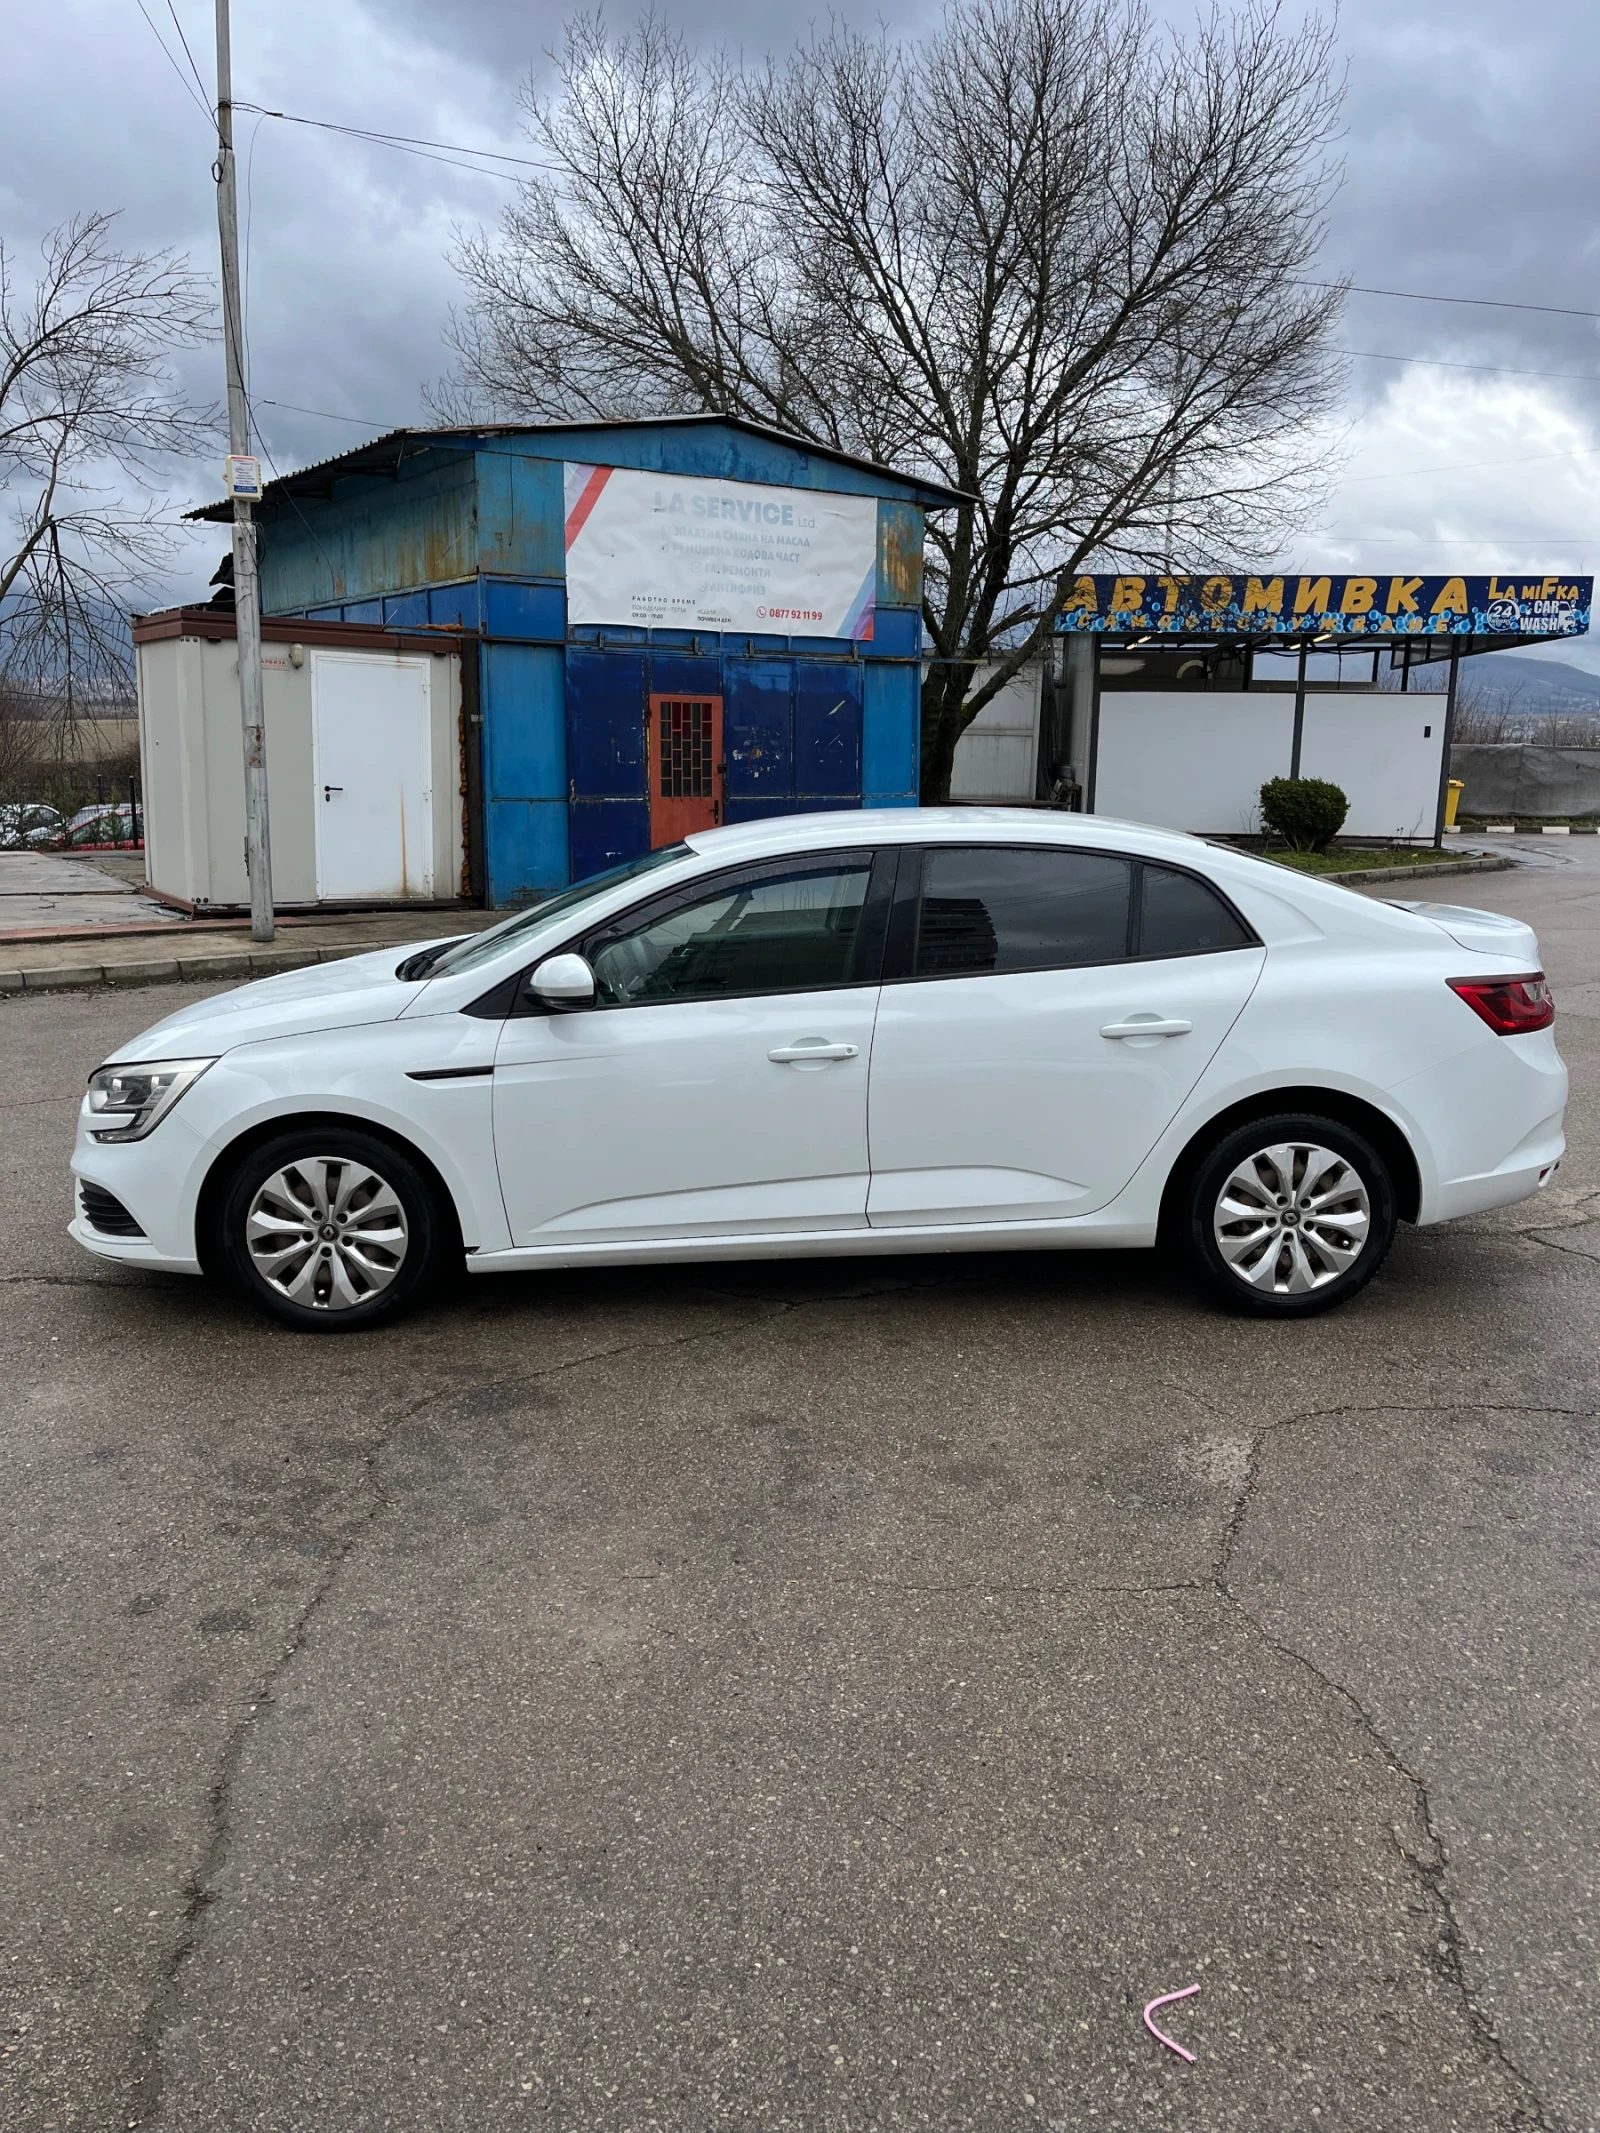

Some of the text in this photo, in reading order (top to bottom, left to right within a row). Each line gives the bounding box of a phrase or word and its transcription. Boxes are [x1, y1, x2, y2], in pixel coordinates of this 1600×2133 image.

[654, 491, 818, 529] LA SERVICE Ltd.
[661, 525, 811, 548] ЗПЛАТНА СМЯНА НА МАСЛА
[717, 545, 731, 557] НА
[733, 548, 774, 561] ХОДОВА
[776, 551, 801, 564] ЧАСТ
[723, 564, 771, 579] РЕМОНТИ
[709, 581, 766, 595] АНТИФРИЗ
[1062, 575, 1469, 613] АВТОМИВКА
[632, 595, 668, 604] РАБОТНО
[1493, 605, 1512, 618] 24
[1534, 600, 1560, 614] CAR
[769, 608, 823, 621] 0877 92 11 99
[1520, 617, 1559, 631] WASH
